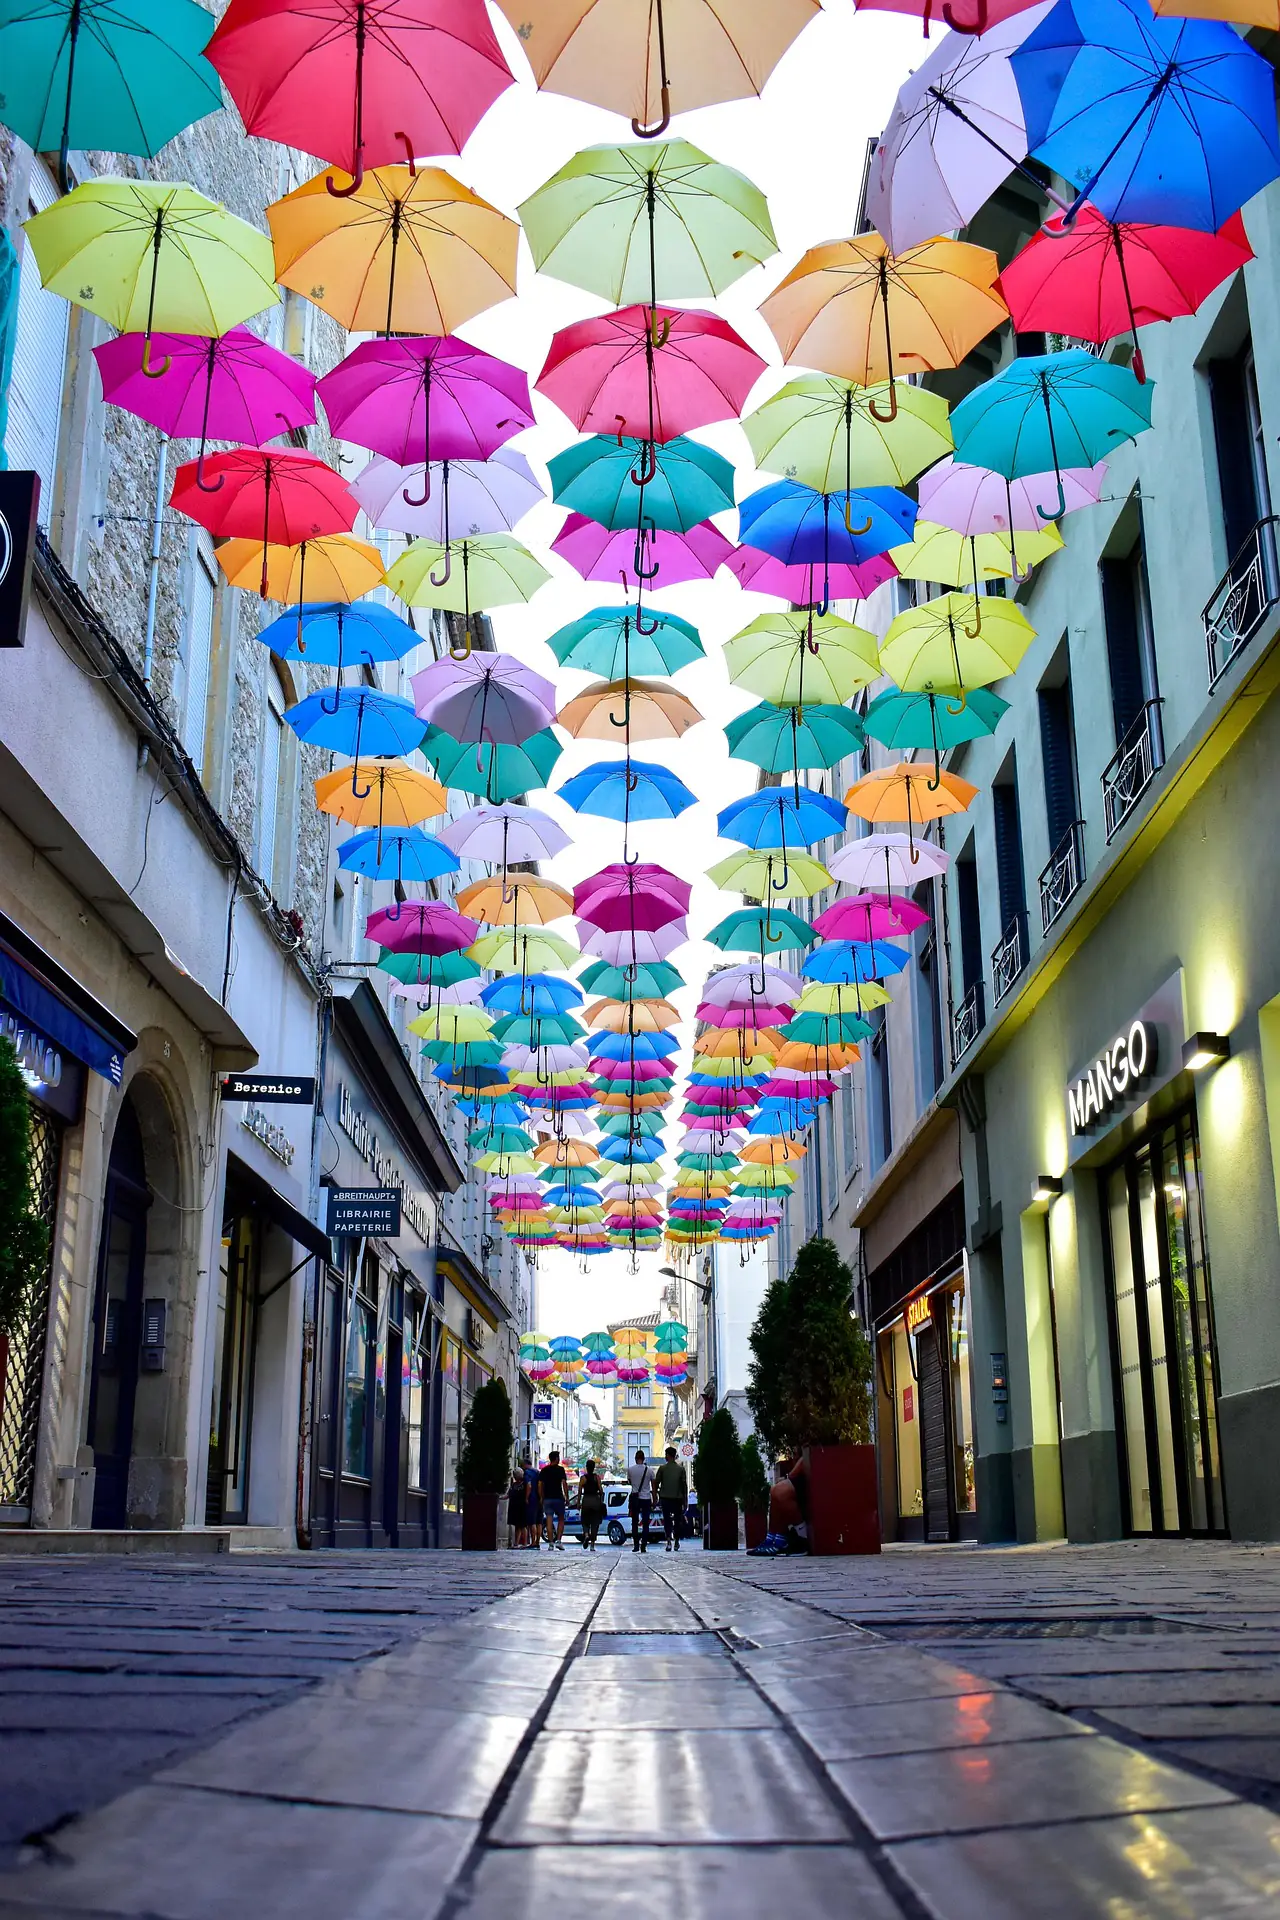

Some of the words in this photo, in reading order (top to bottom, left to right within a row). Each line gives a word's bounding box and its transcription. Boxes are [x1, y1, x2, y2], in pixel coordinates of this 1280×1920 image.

[1068, 1020, 1147, 1136] MANGO
[233, 1081, 302, 1095] Berenice
[338, 1192, 391, 1200] BREITHAUPT
[336, 1210, 392, 1218] LIBRAIRIE
[334, 1223, 392, 1232] PAPETERIE
